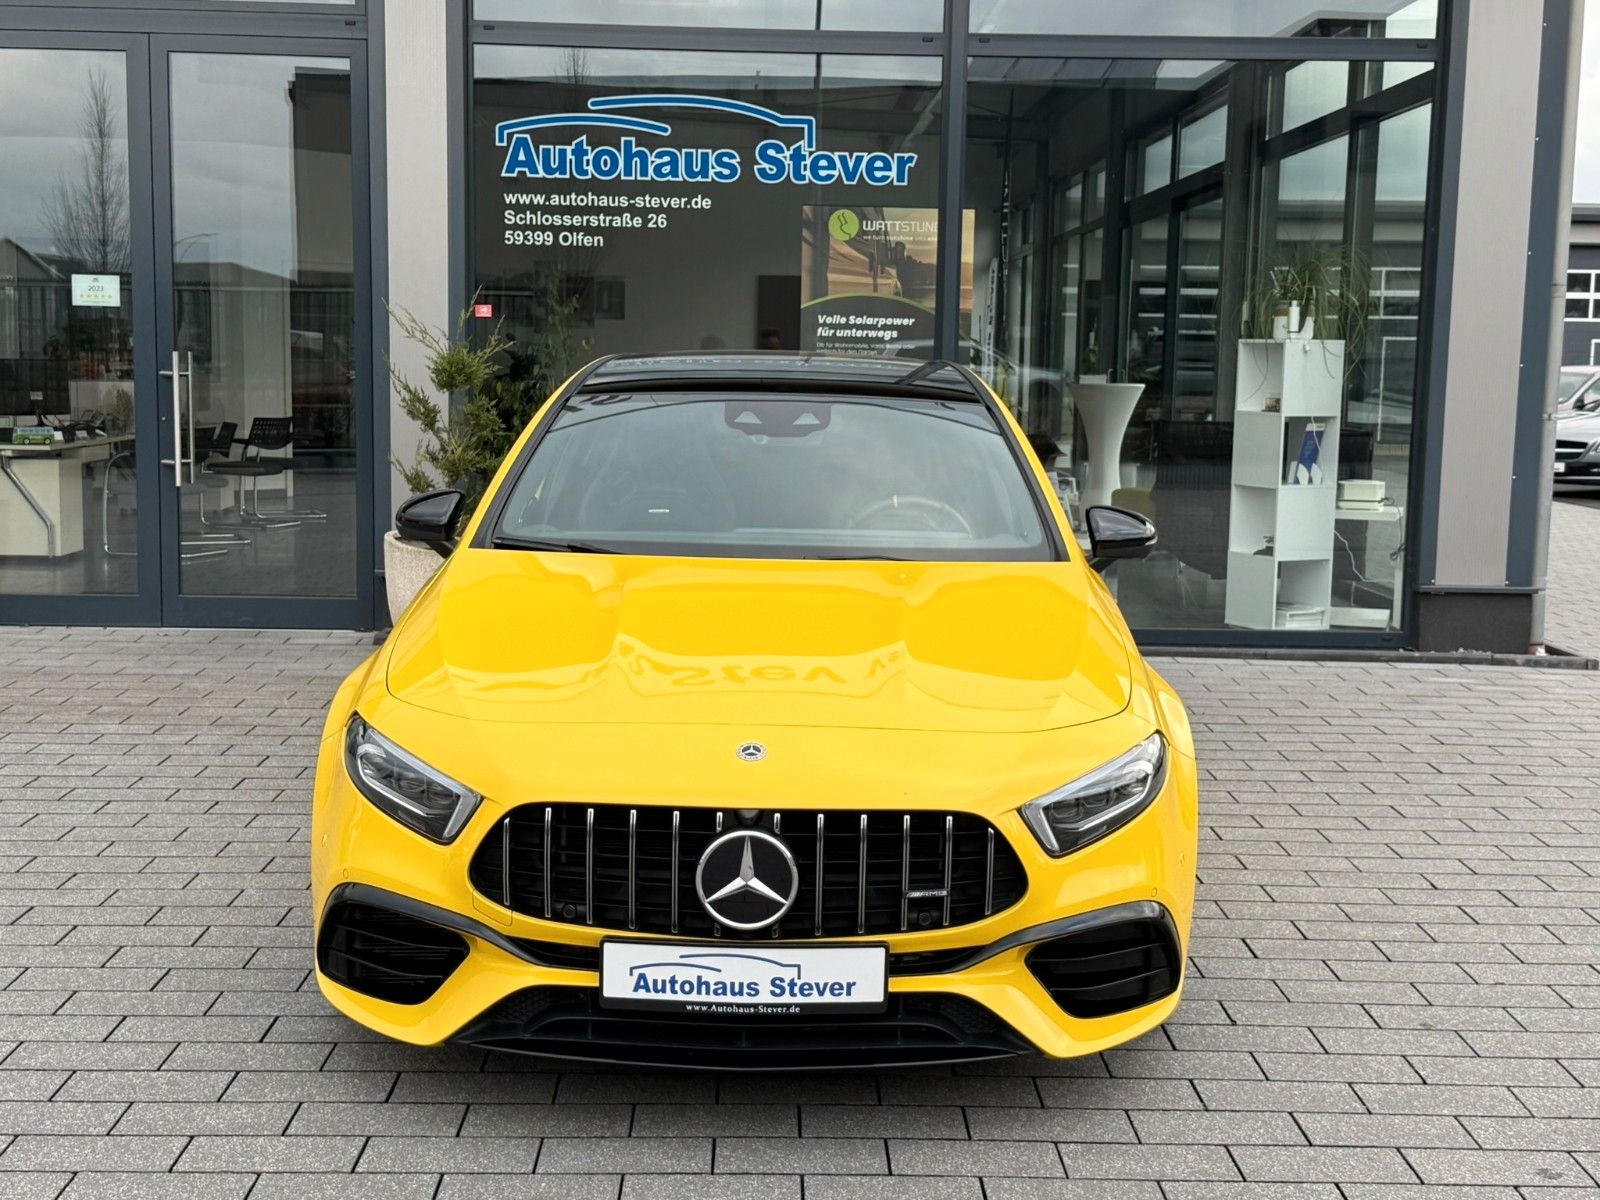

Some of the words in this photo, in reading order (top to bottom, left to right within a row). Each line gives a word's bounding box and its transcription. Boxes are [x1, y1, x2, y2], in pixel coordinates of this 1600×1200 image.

[501, 133, 742, 183] Autohaus
[754, 138, 919, 187] Stever
[503, 192, 712, 210] www.autohaus-stever.de
[503, 210, 643, 229] Schlosserstraße
[647, 213, 668, 229] 26
[503, 230, 555, 246] 59399
[558, 231, 604, 248] Olfen
[817, 314, 848, 325] Volle
[848, 315, 916, 328] Solarpower
[816, 326, 835, 338] für
[836, 328, 899, 341] unterwegs
[632, 972, 760, 997] Autohaus
[769, 976, 857, 998] Stever
[685, 1003, 801, 1015] www.Autohaus-Stever.de
